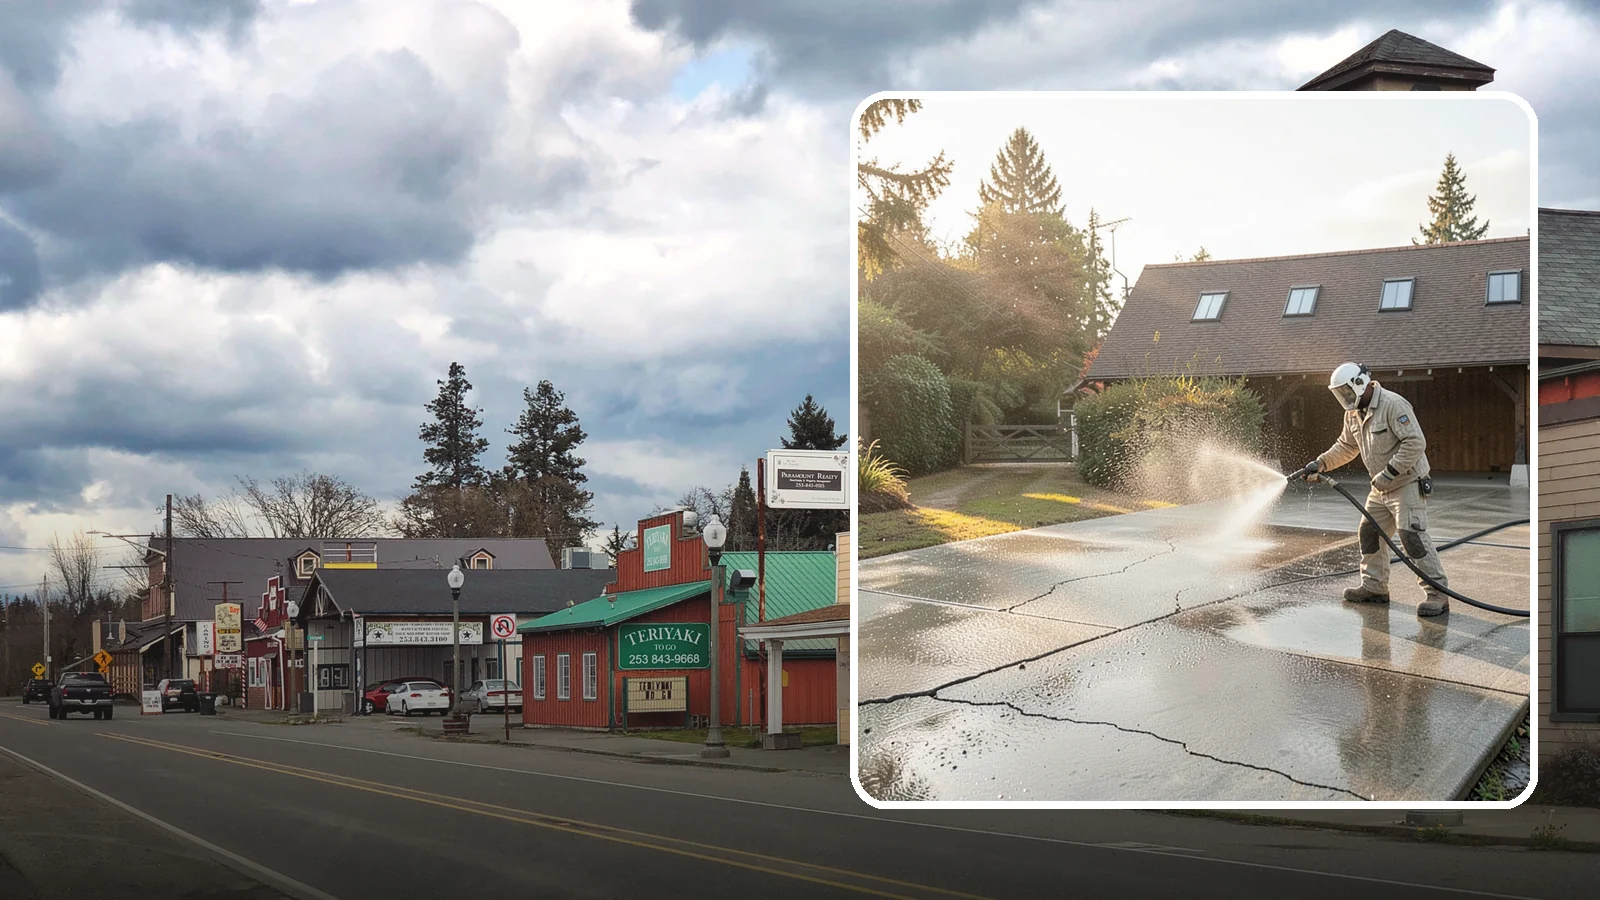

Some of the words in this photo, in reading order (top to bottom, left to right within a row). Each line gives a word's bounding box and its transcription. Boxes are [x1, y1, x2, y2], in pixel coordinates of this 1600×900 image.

[817, 472, 839, 480] REALTY
[646, 531, 669, 549] TERIYAKI
[625, 627, 702, 646] TERIYAKI
[654, 643, 665, 651] TO
[665, 643, 677, 651] GO
[628, 654, 649, 665] 253
[651, 653, 700, 664] 843-9668
[639, 681, 673, 690] TERIYAKI
